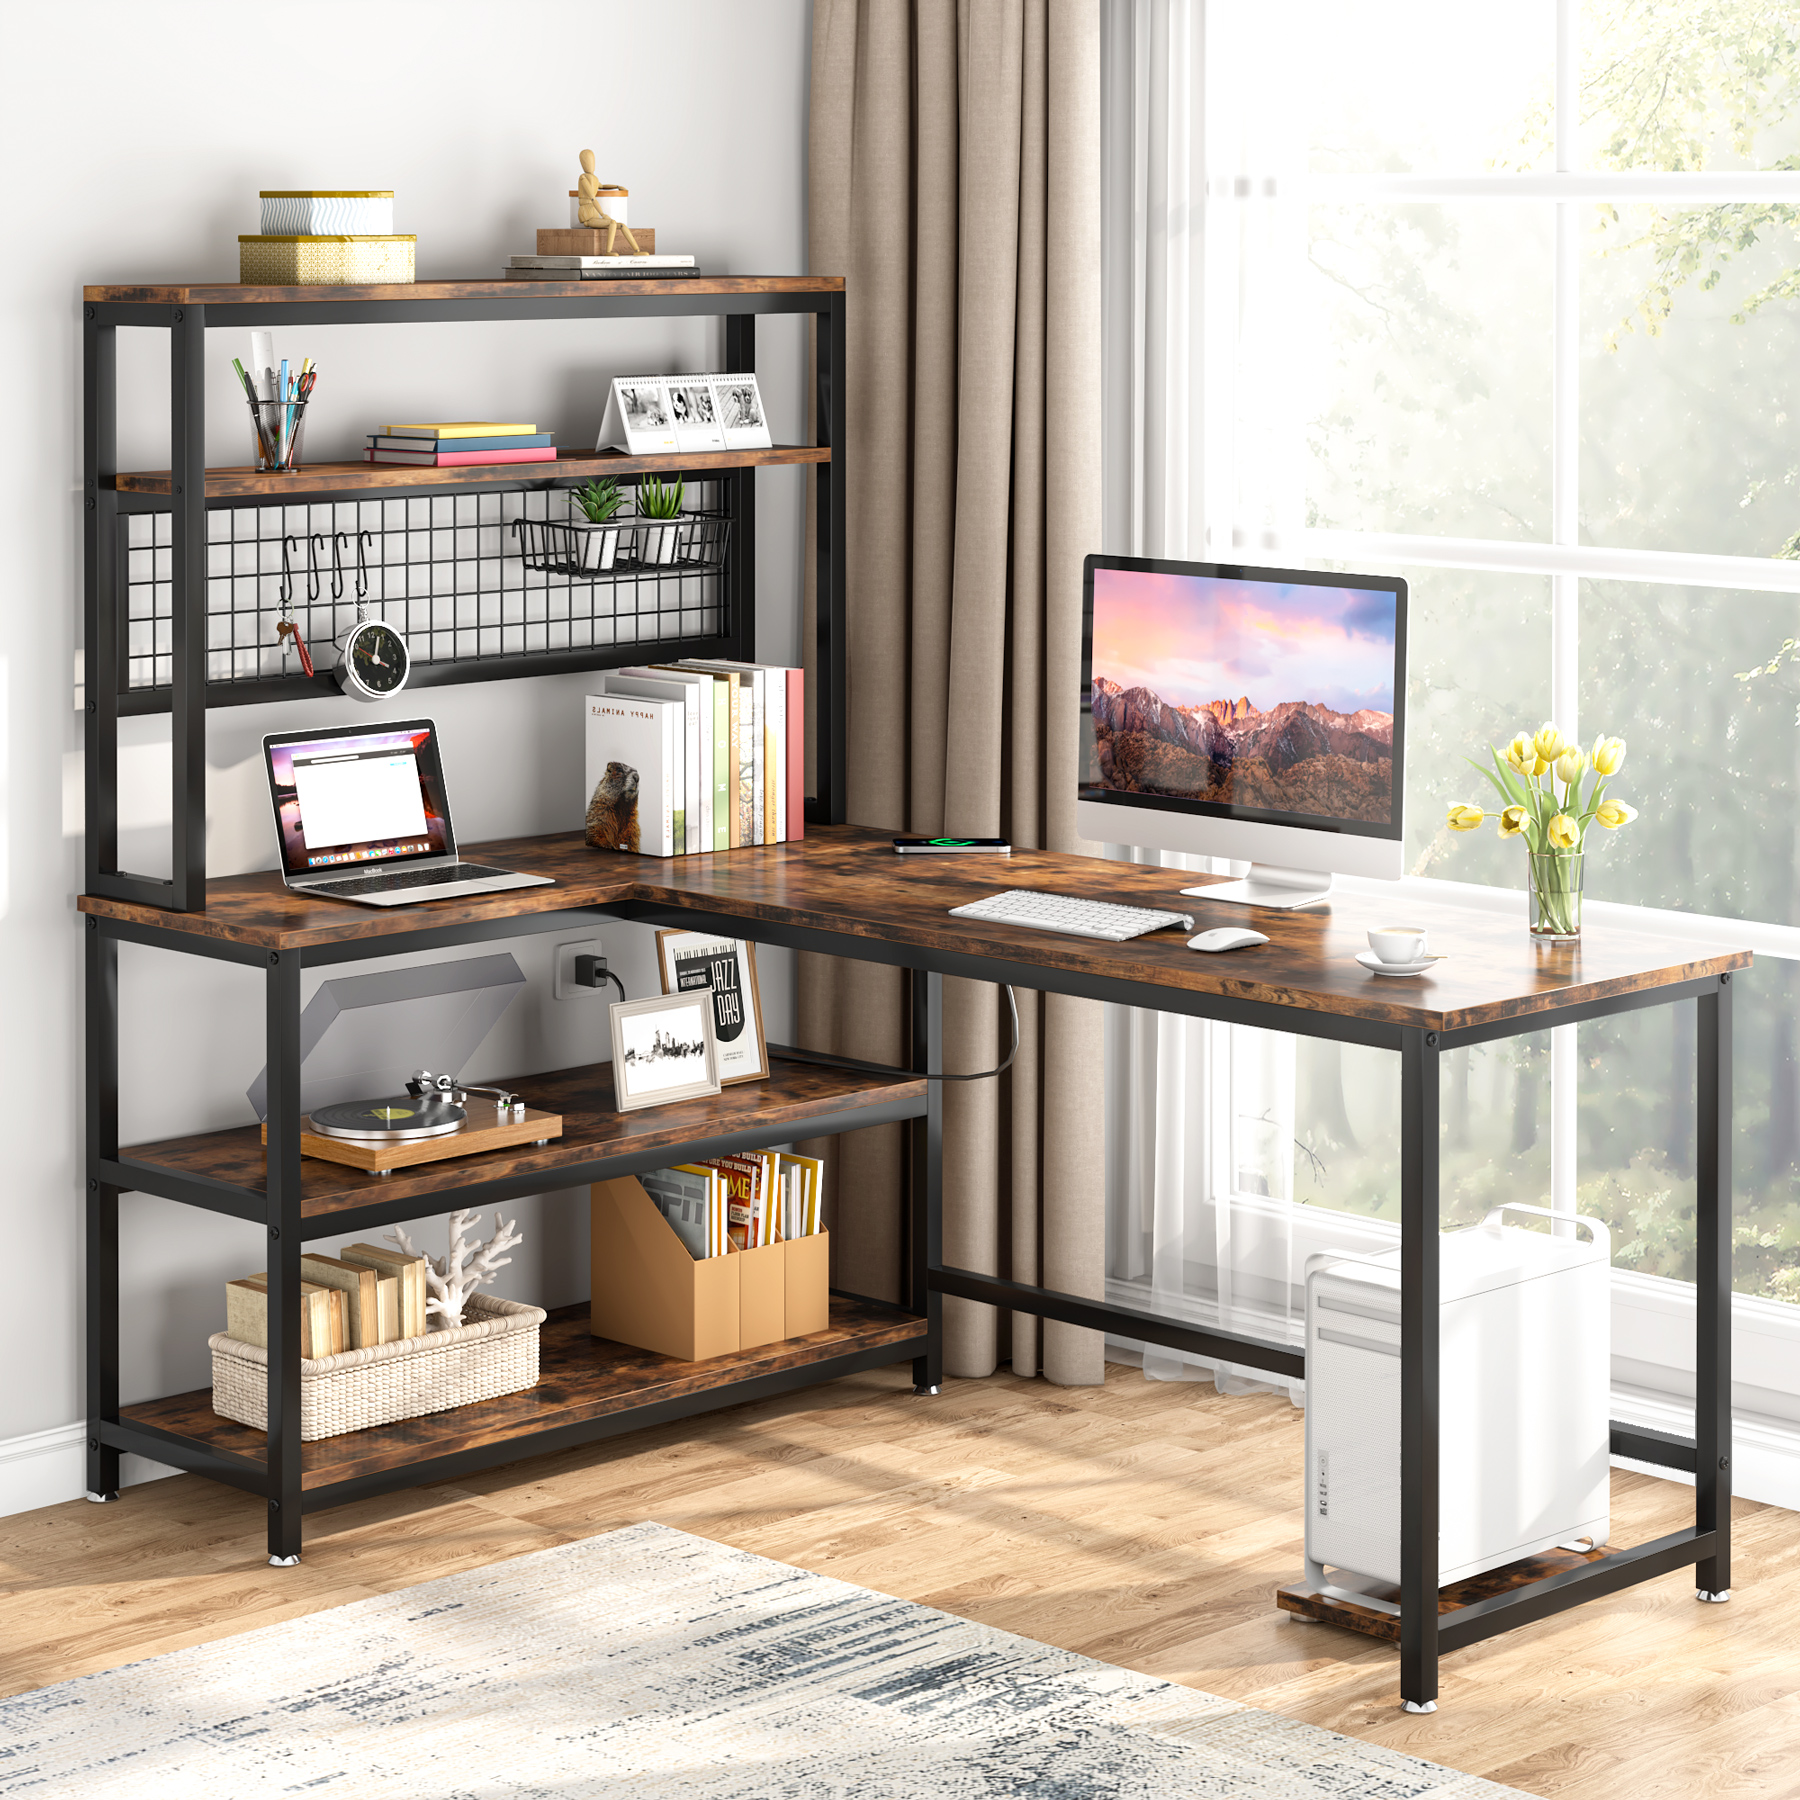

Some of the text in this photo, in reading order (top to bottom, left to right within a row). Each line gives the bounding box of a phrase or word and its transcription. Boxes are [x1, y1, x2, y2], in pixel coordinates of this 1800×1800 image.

[367, 631, 375, 639] 12
[392, 653, 397, 661] 3
[392, 667, 397, 675] 4
[376, 680, 382, 688] 6
[387, 677, 392, 685] 5
[731, 680, 739, 748] YOUR WAY
[718, 697, 727, 834] HOME
[363, 867, 383, 875] MacBook
[710, 958, 737, 992] JAZZ
[717, 992, 741, 1026] DAY
[741, 1151, 762, 1163] BUILD
[721, 1160, 733, 1170] YOU
[733, 1163, 752, 1174] BUILD
[717, 1172, 751, 1200] OME
